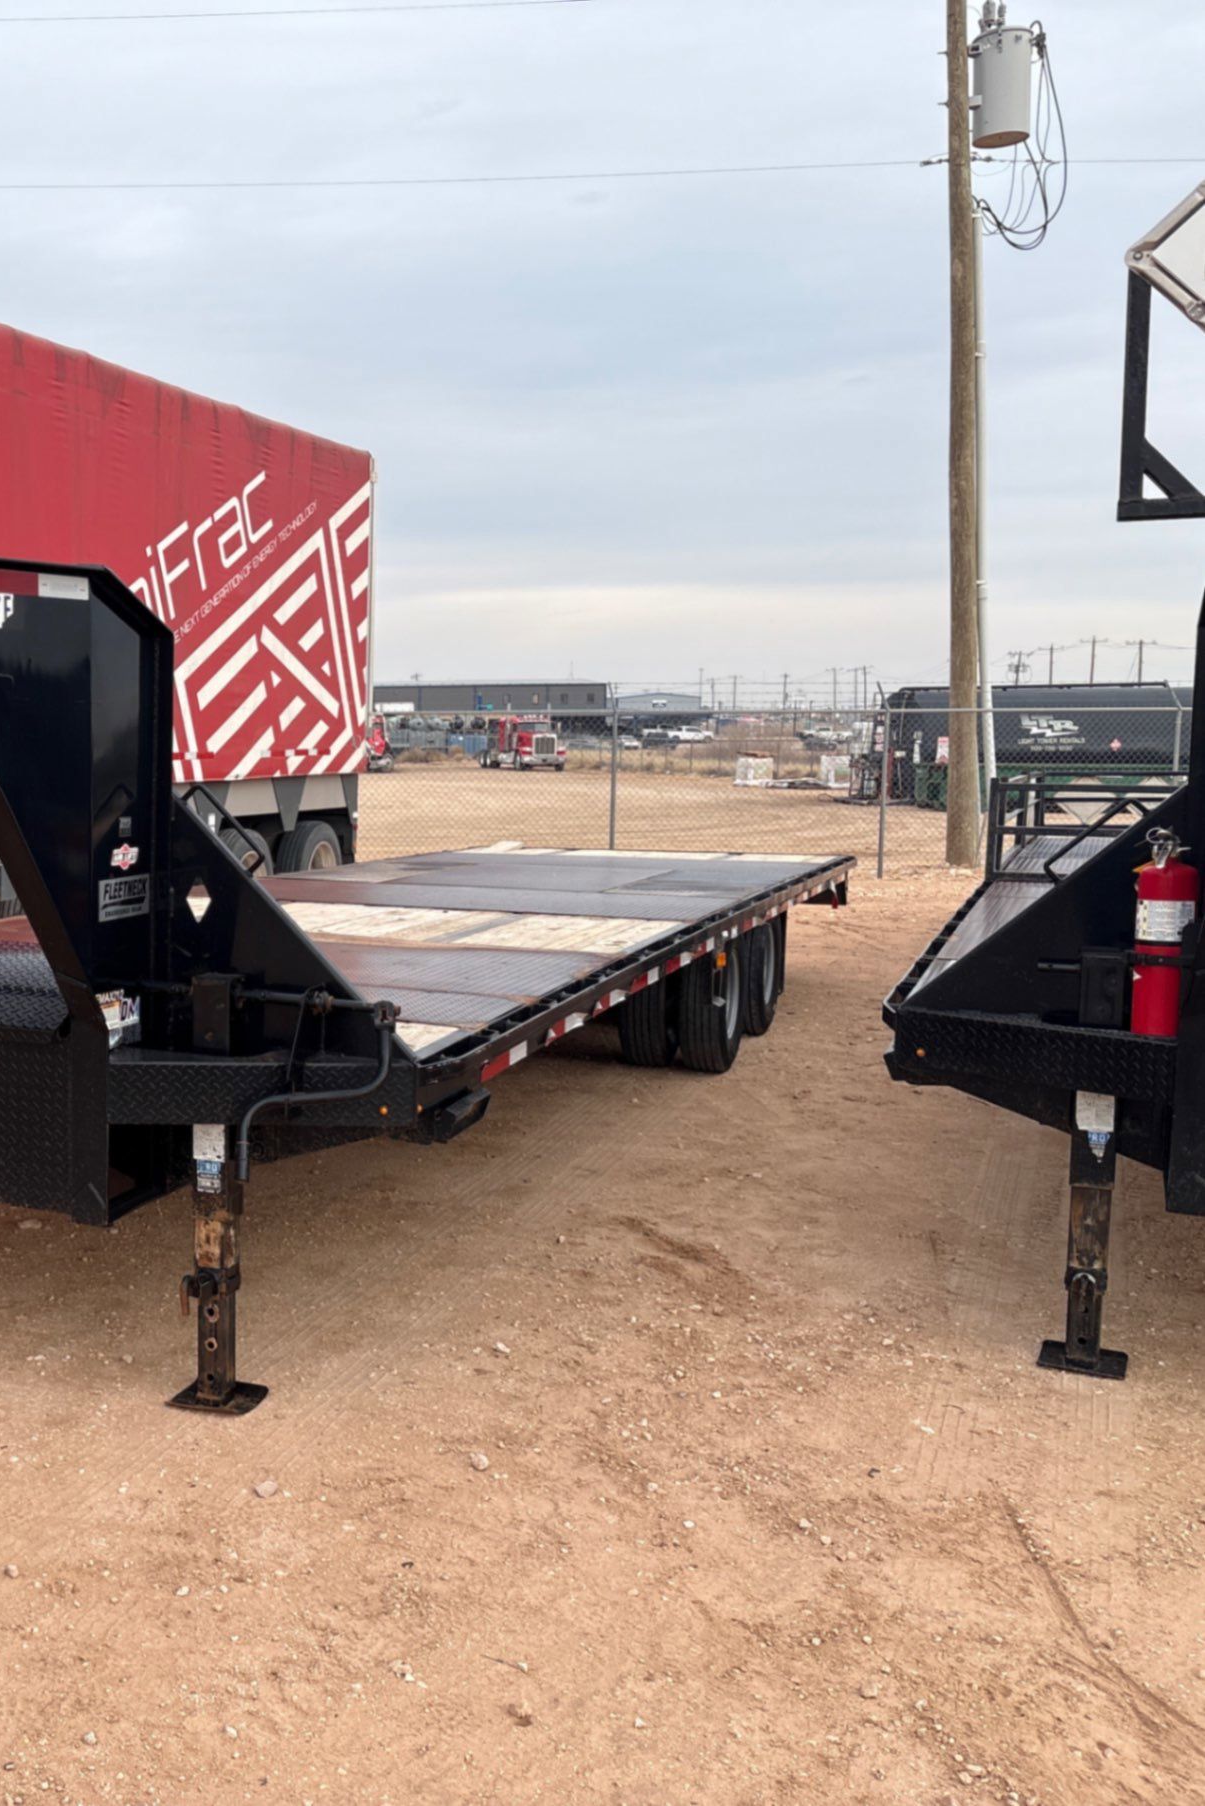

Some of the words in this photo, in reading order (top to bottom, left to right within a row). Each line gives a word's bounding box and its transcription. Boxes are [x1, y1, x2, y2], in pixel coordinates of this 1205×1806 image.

[180, 615, 200, 638] NEXT
[1019, 713, 1080, 731] LTR
[1059, 736, 1085, 744] RENTALS
[104, 877, 148, 901] FLEETNECK
